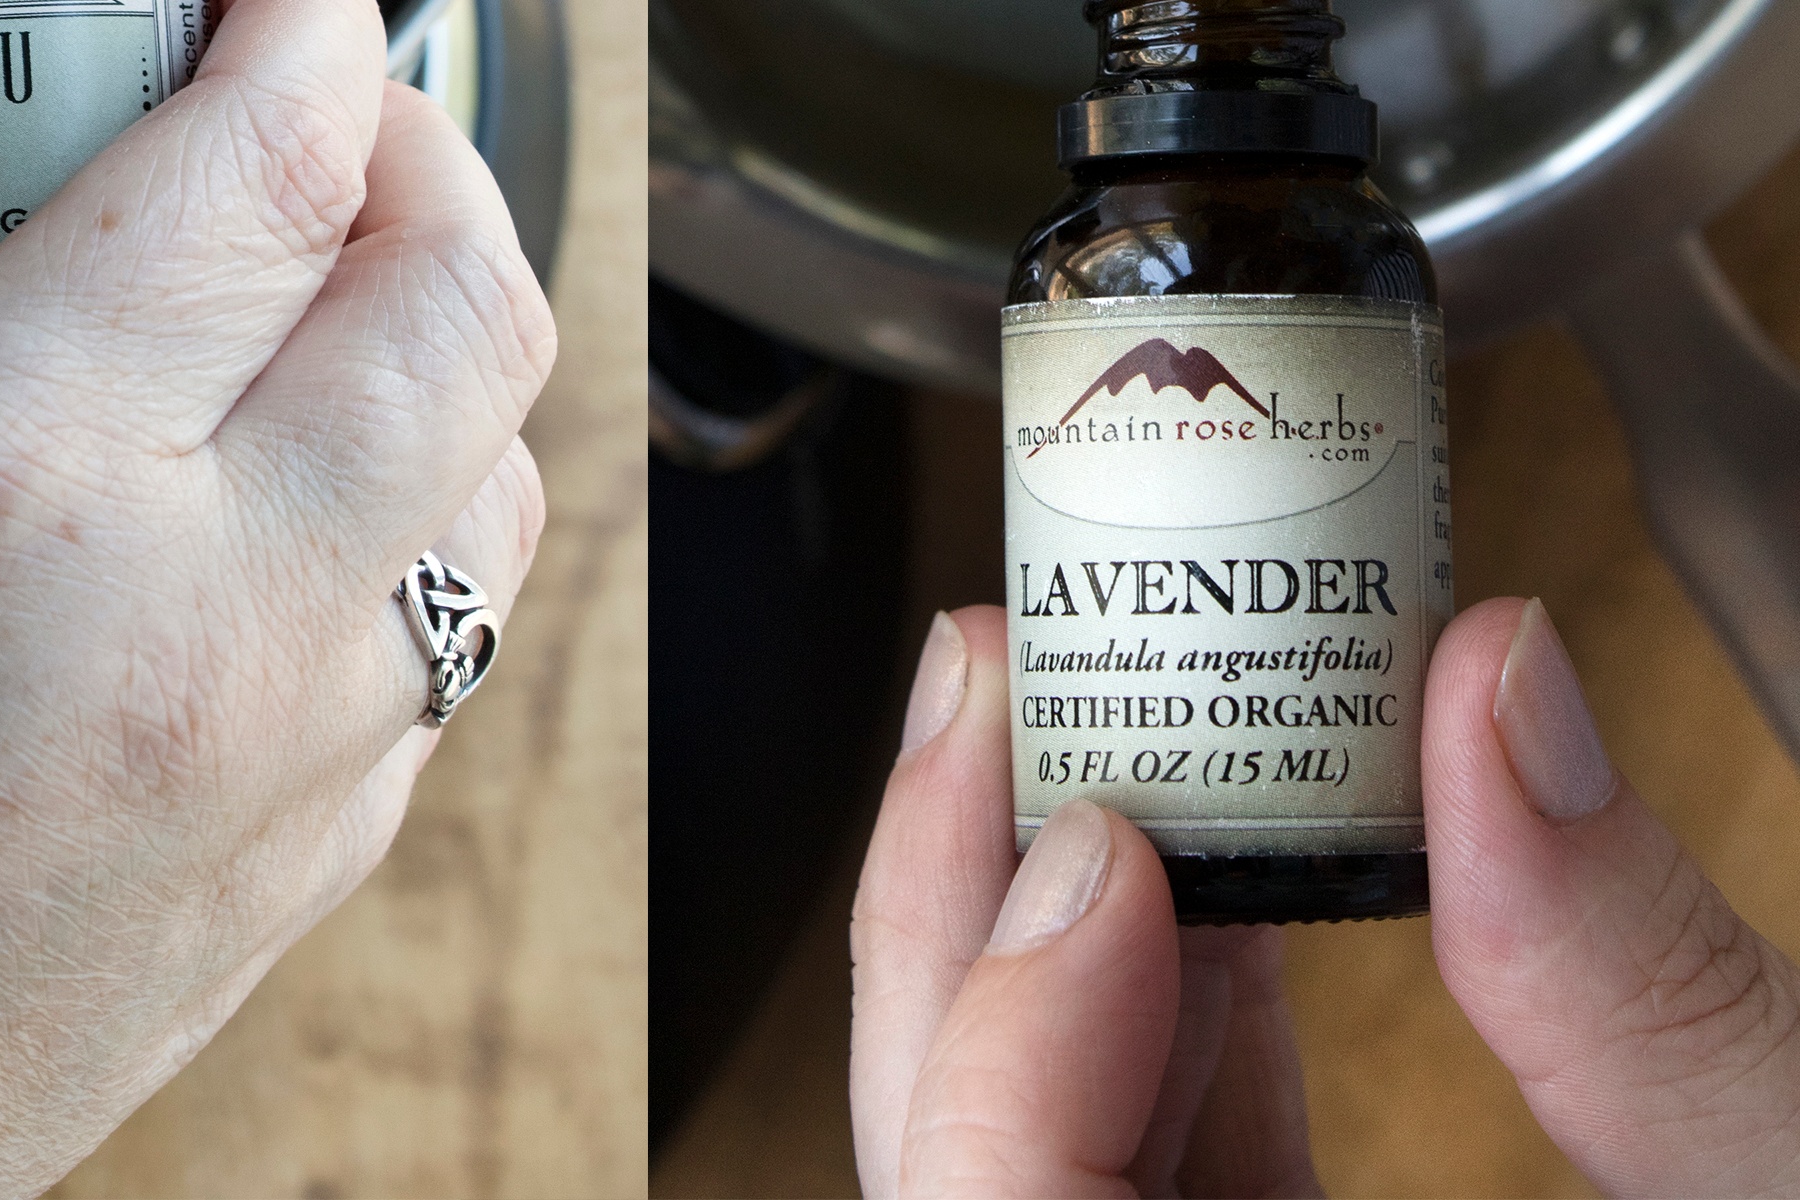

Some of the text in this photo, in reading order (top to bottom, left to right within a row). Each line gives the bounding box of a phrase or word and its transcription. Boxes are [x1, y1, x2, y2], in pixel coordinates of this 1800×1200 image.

[1018, 415, 1162, 447] mountain
[1175, 419, 1257, 441] rose
[1019, 559, 1399, 617] LAVENDER
[1019, 637, 1393, 682] (Lavandula angustifolia)
[1022, 694, 1399, 729] CERTIFIED ORGANIC
[1038, 747, 1350, 788] 0.5 FL OZ (15 ML)
